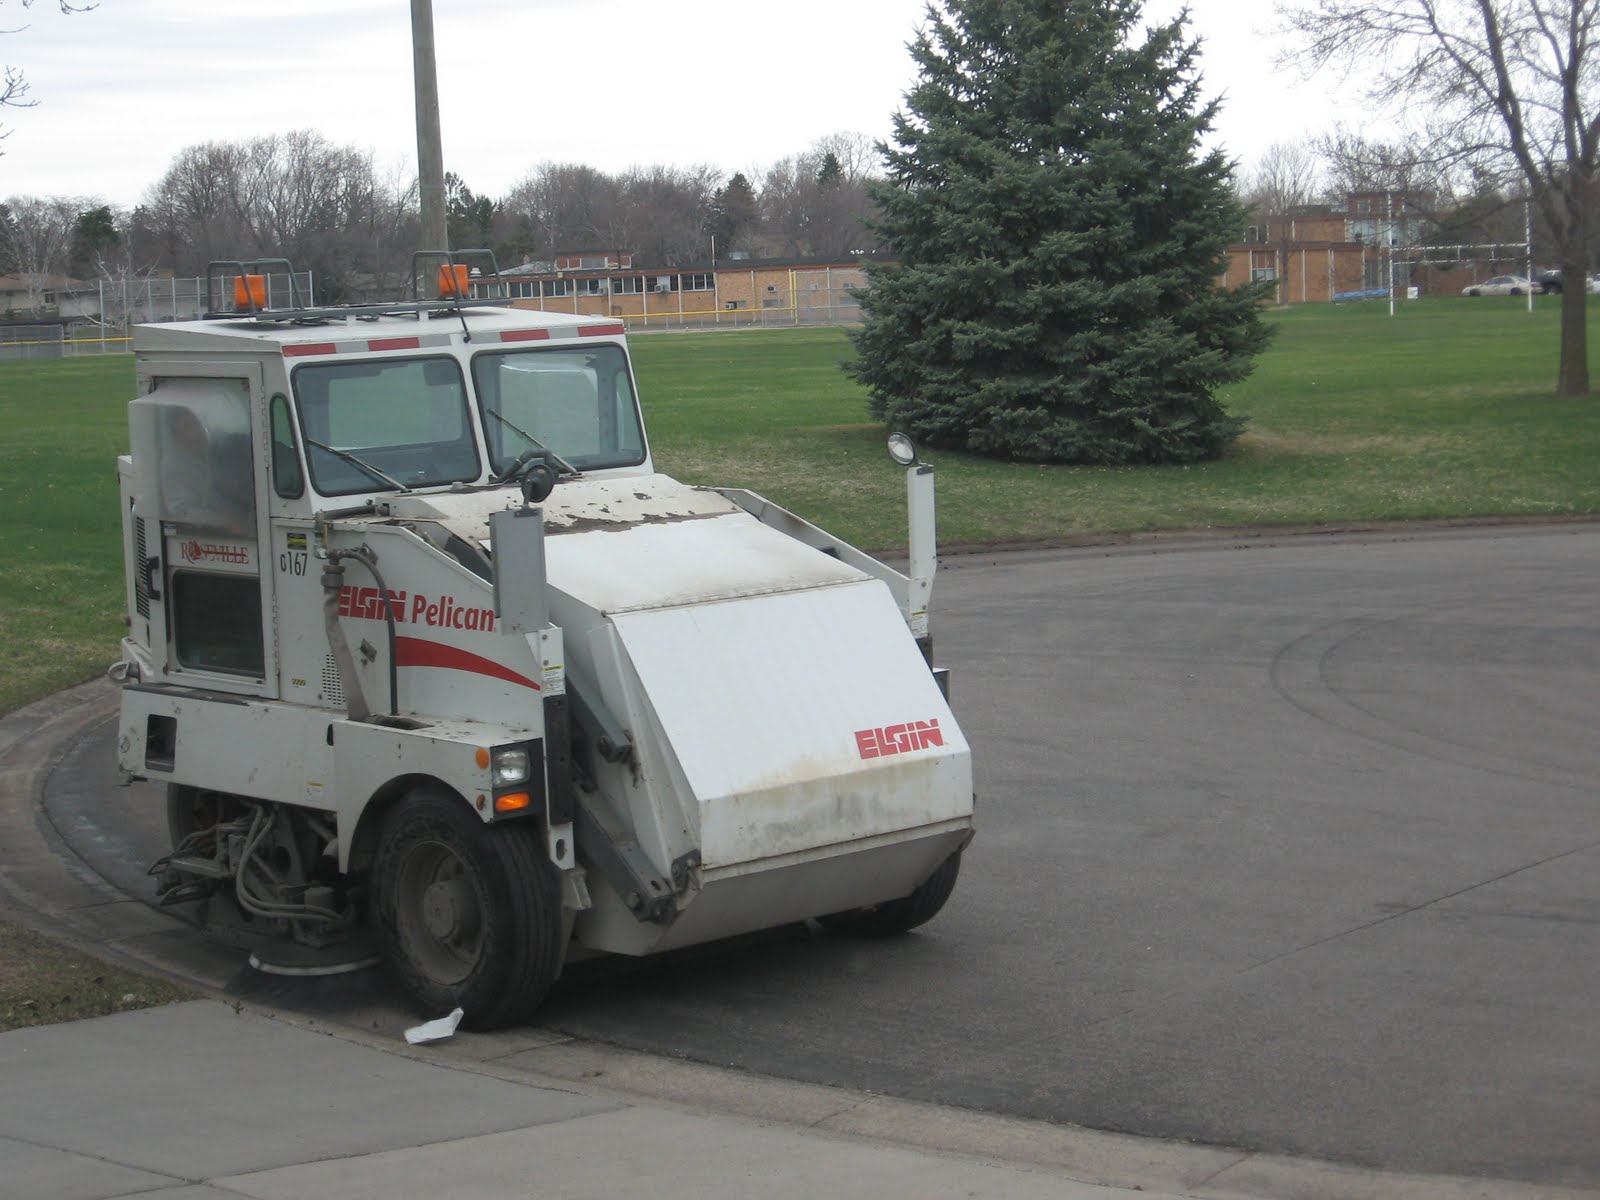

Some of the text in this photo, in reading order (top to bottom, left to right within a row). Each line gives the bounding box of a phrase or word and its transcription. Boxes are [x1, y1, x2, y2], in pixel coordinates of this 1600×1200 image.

[337, 585, 495, 632] ELGIN Pelican
[854, 718, 944, 760] ELGIN
